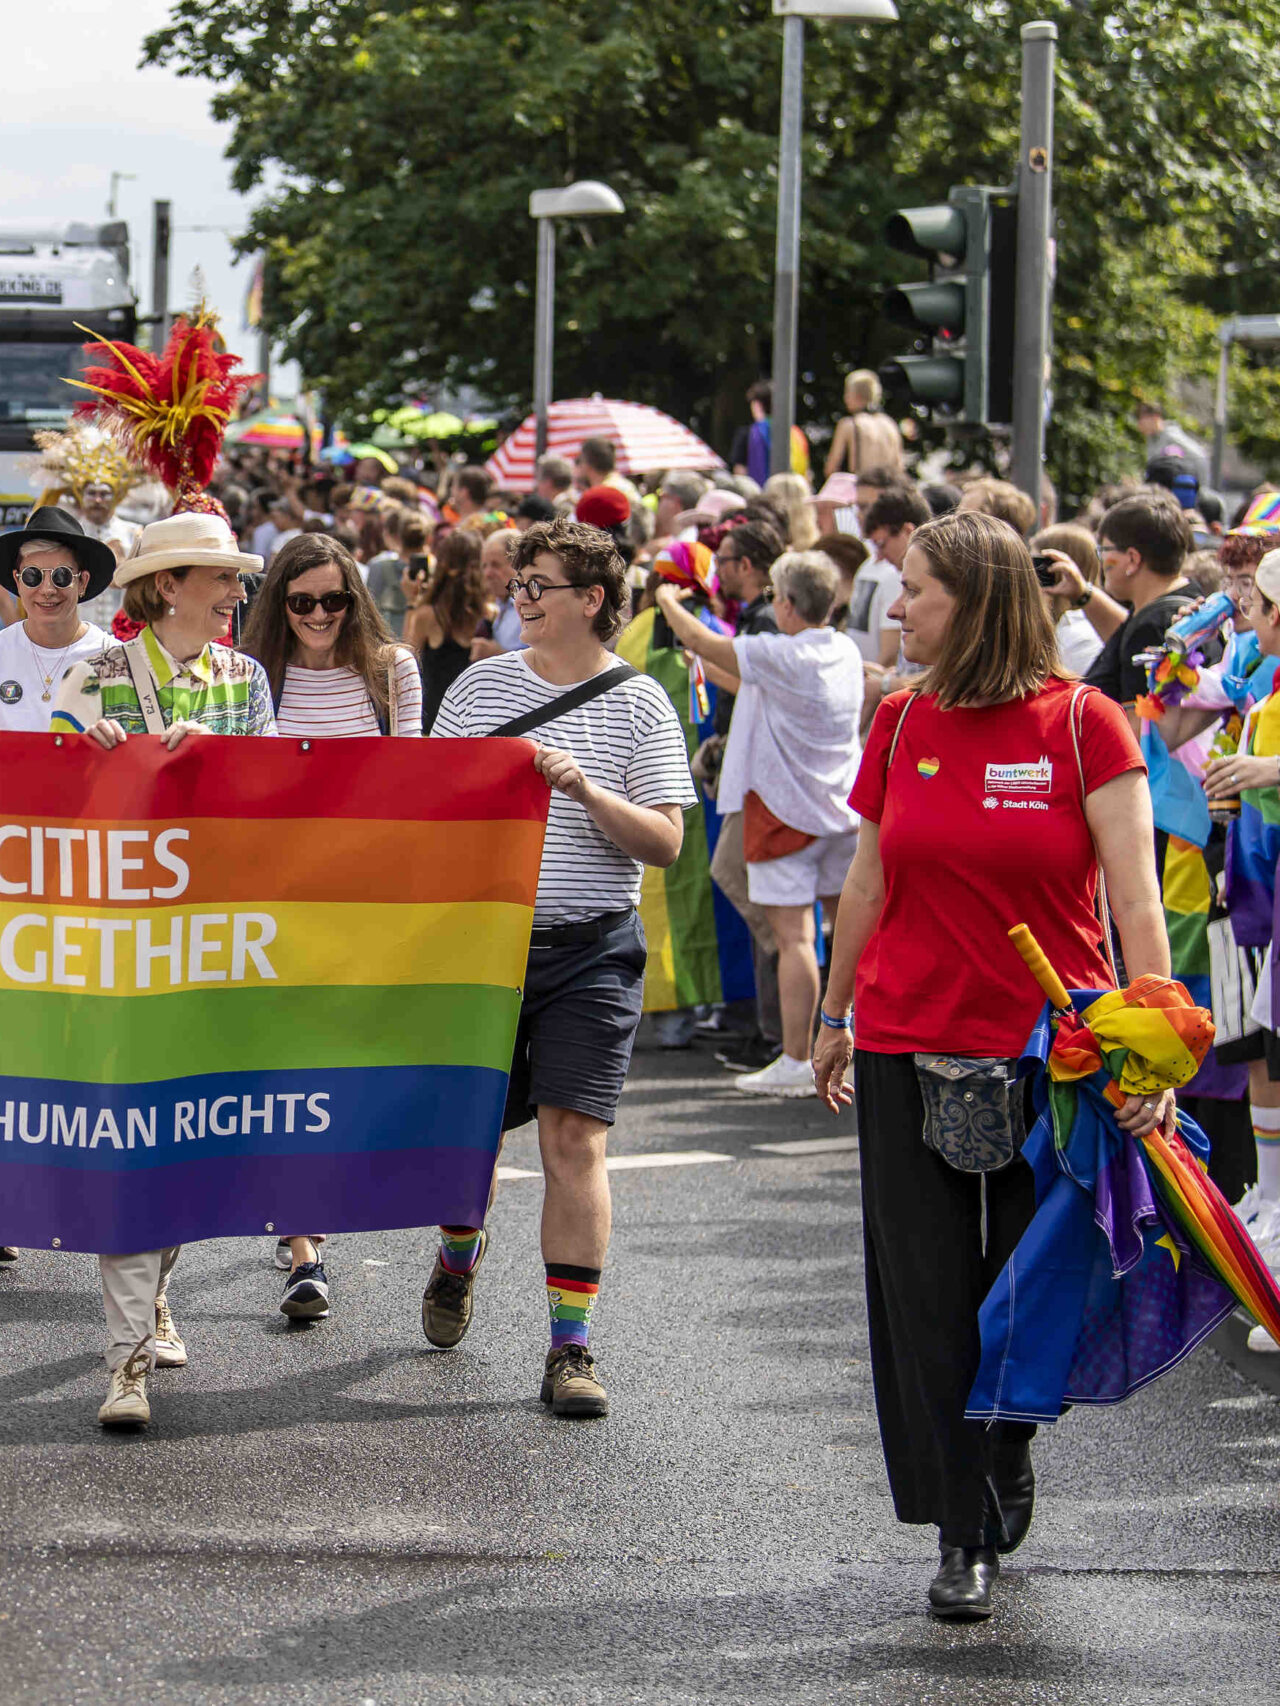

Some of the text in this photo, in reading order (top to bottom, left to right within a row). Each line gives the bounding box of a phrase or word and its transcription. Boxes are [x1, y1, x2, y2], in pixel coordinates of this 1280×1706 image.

[989, 768, 1049, 778] buntwerk
[1002, 800, 1049, 810] Stadt Köln
[174, 1092, 331, 1143] RIGHTS
